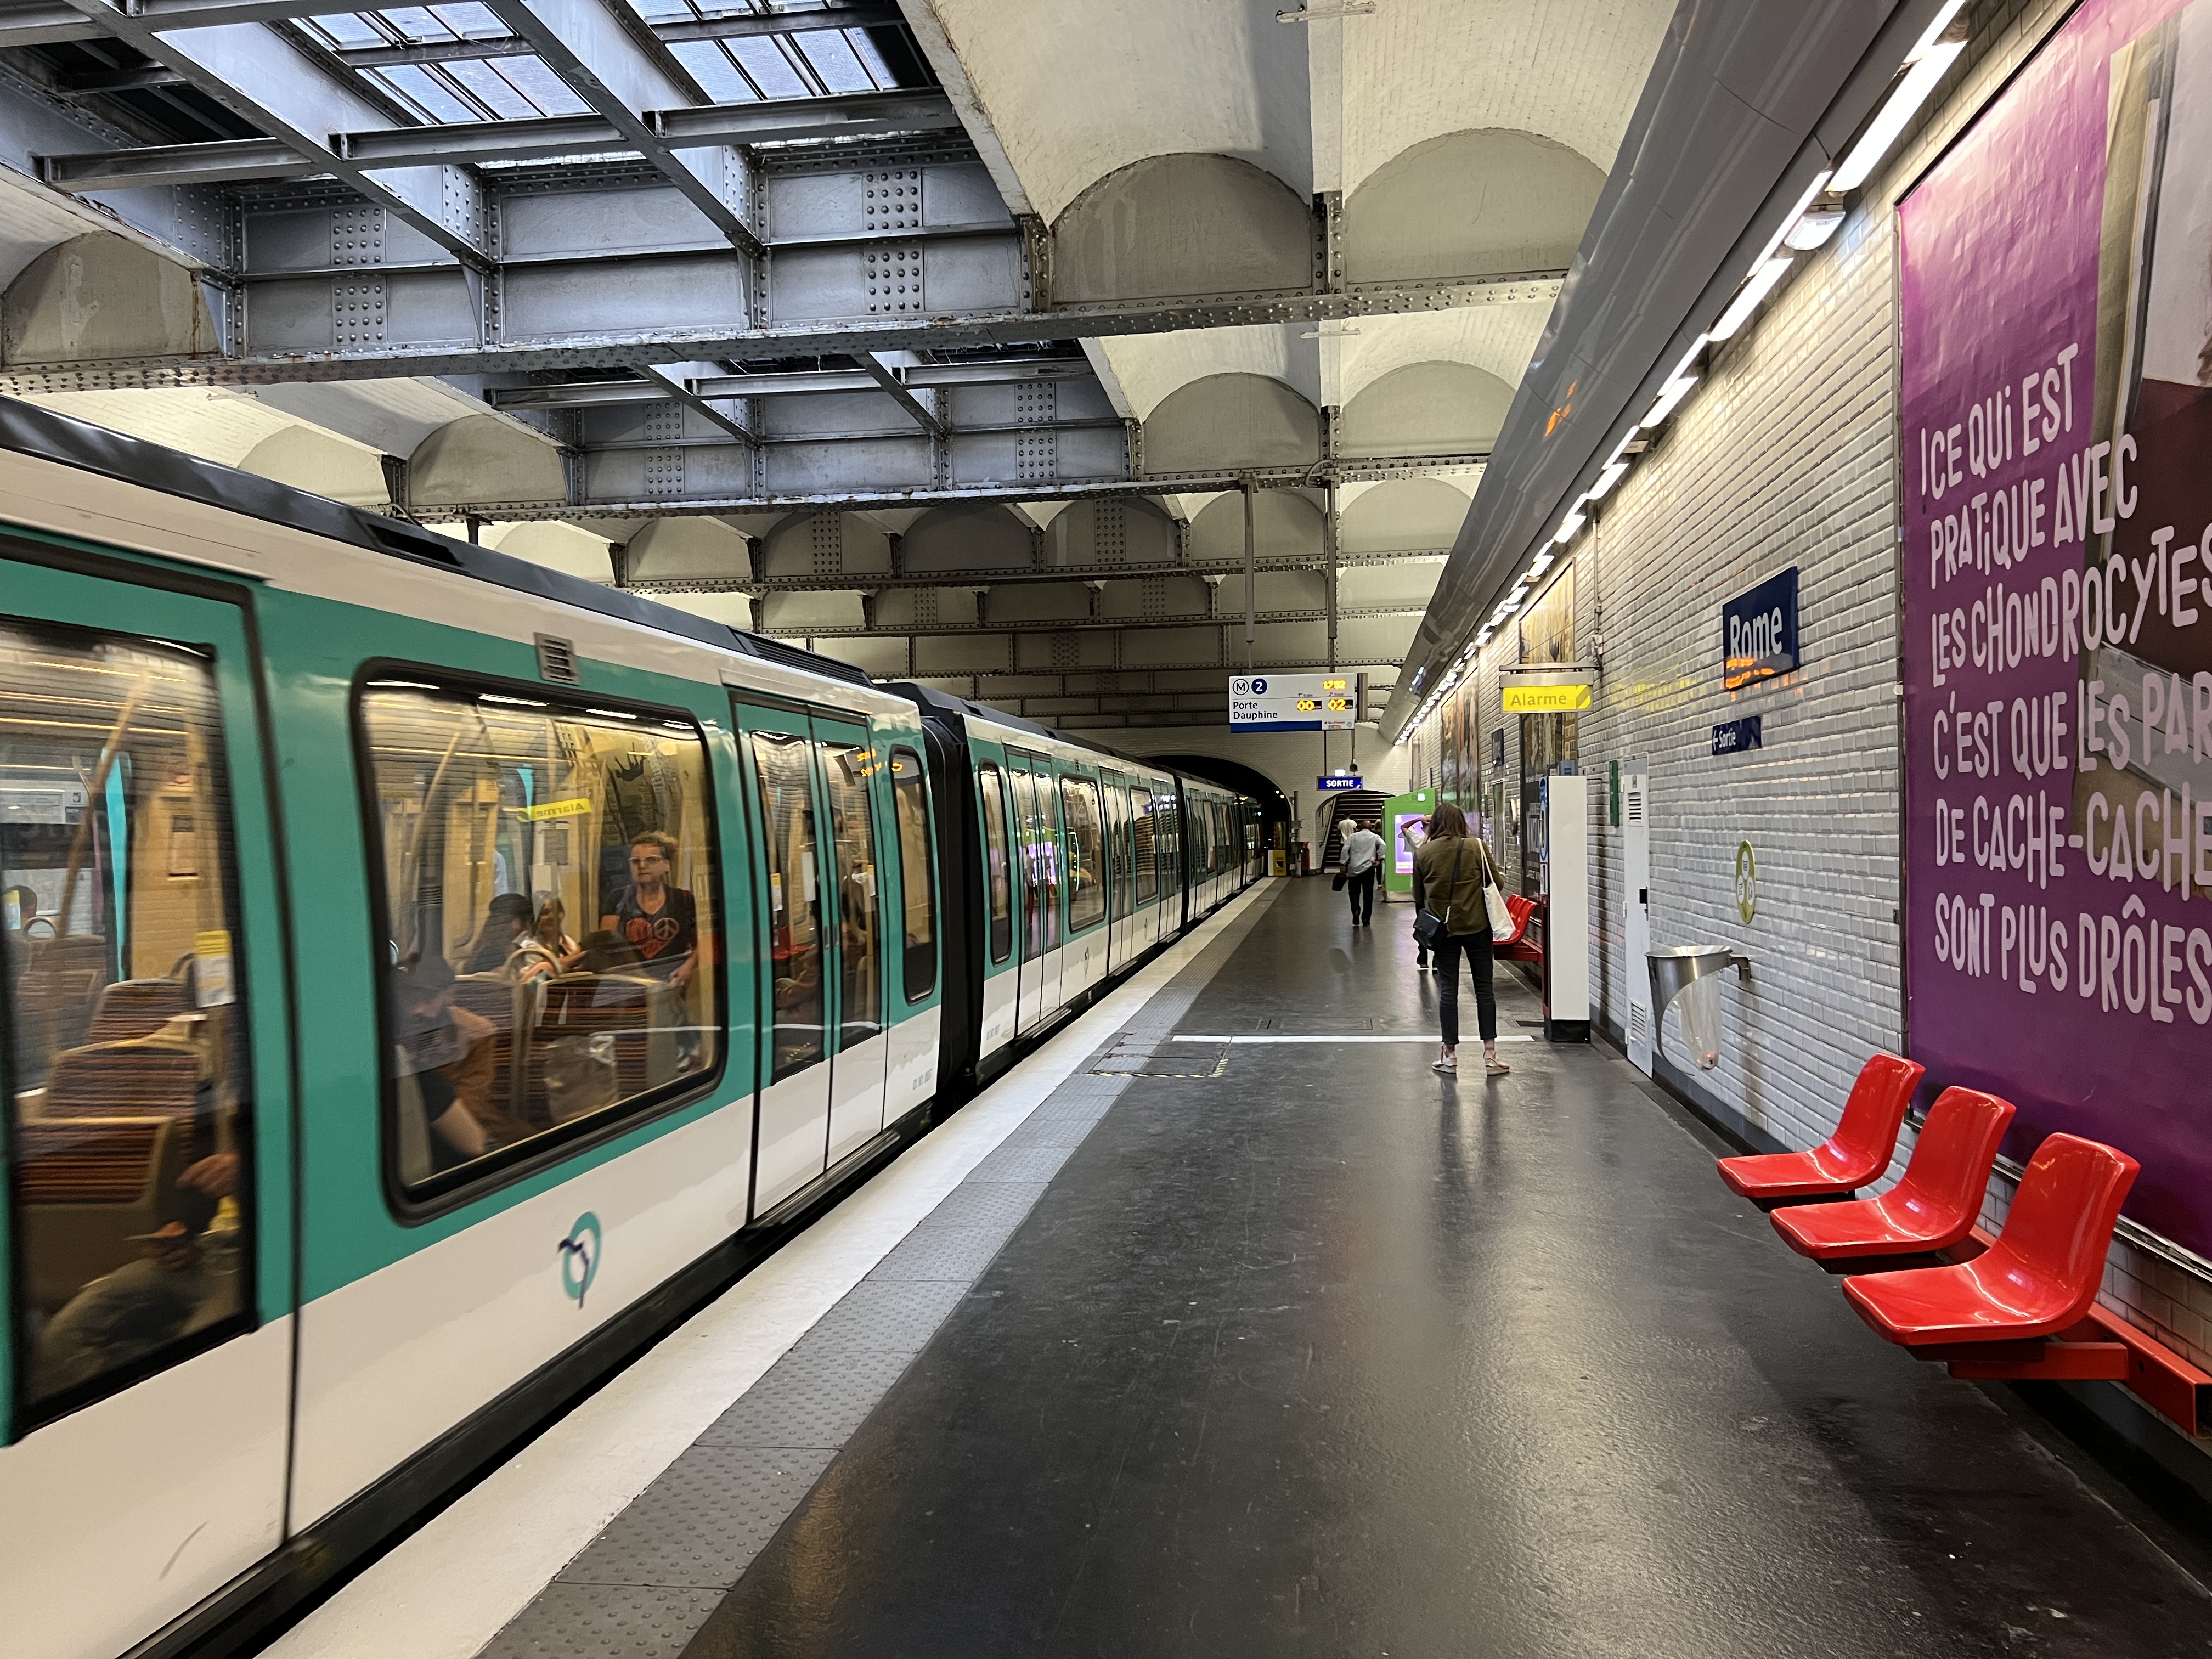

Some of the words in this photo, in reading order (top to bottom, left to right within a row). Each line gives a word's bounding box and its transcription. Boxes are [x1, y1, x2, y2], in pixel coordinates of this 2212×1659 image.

[2023, 342, 2078, 456] EST
[2054, 433, 2138, 548] AVEC
[1730, 607, 1782, 670] Rome
[1932, 608, 1966, 687] LES
[1233, 710, 1278, 721] Dauphine
[1236, 682, 1245, 691] M
[1256, 681, 1263, 691] 2
[1297, 700, 1314, 712] 00
[1328, 698, 1346, 710] 02
[1510, 693, 1567, 706] Alarme
[1719, 727, 1736, 748] Sortie
[1934, 691, 2004, 780] C'EST
[2011, 692, 2068, 781] QUE
[2078, 679, 2130, 772] LES
[2143, 672, 2212, 766] PAR
[1936, 799, 1965, 866] DE
[1973, 781, 2212, 901] CACHE-CACHE
[1935, 893, 1995, 977] SONT
[2001, 905, 2068, 994] PLUS
[2079, 894, 2212, 1025] DRÔLES
